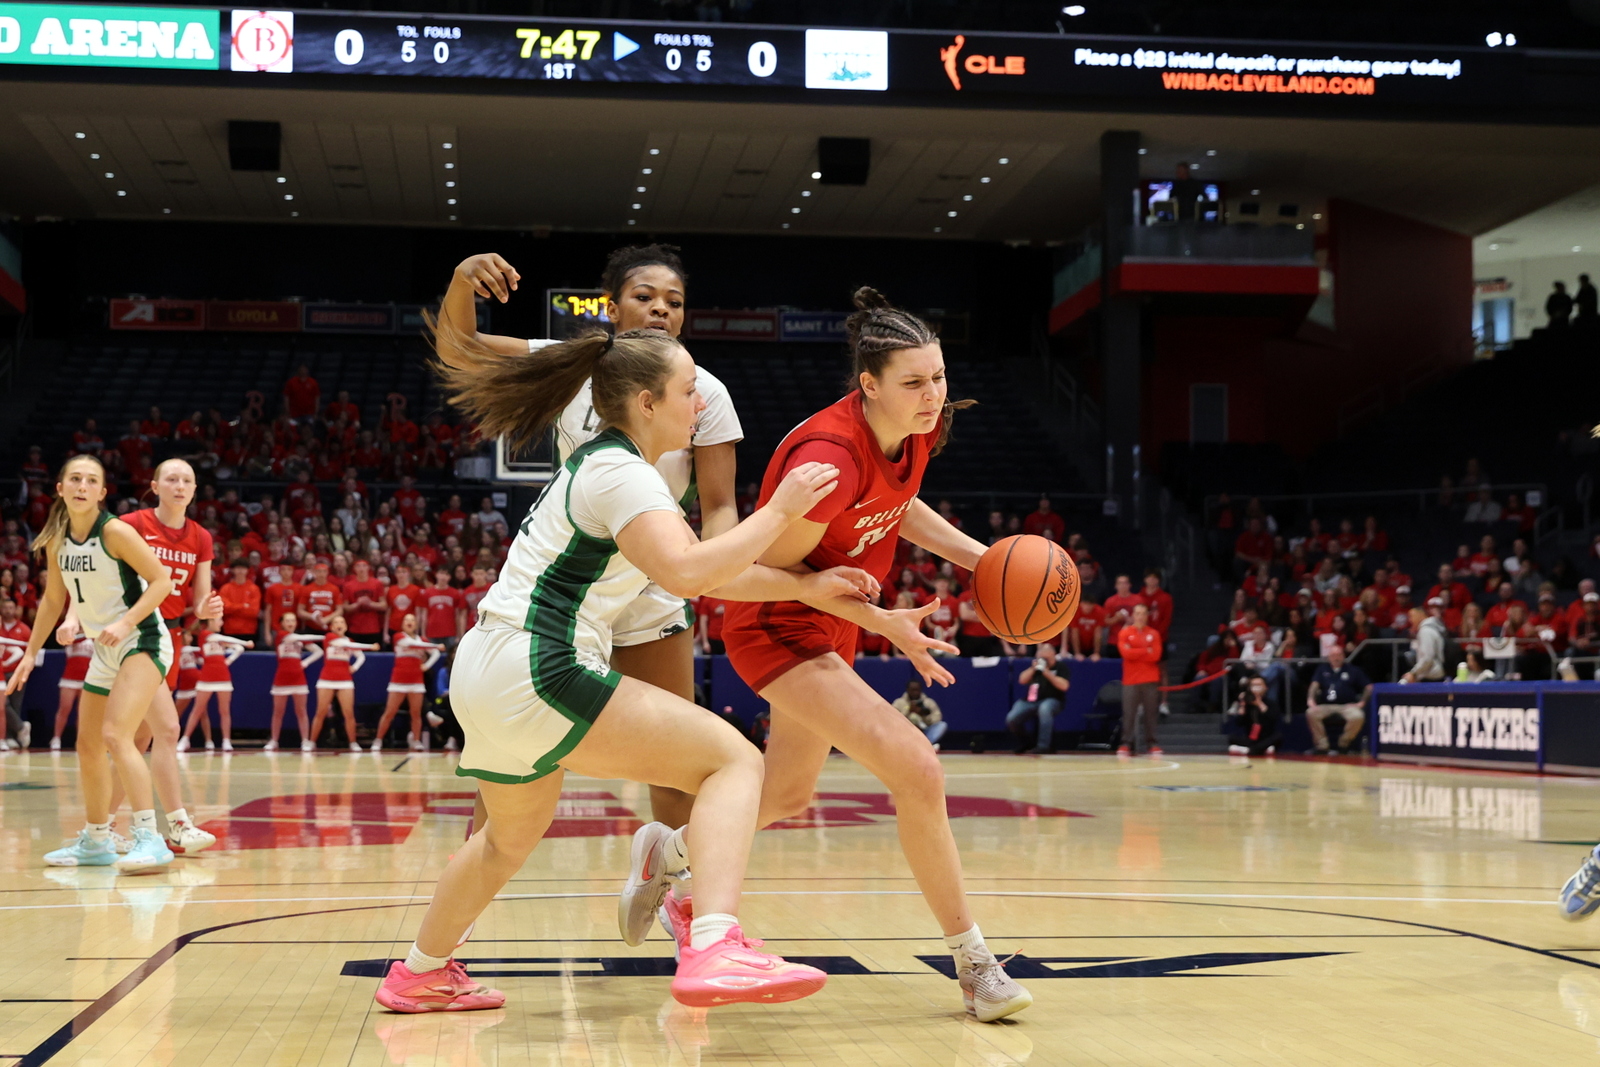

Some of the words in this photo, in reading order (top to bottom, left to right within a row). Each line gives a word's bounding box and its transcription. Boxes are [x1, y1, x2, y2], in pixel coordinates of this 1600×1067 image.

[30, 17, 215, 60] ARENA
[397, 26, 419, 39] TOL
[424, 26, 462, 40] FOULS
[516, 28, 601, 61] 7:47
[654, 33, 691, 47] FOULS
[691, 34, 714, 48] TOL
[334, 29, 365, 66] 0
[401, 40, 416, 63] 5
[433, 41, 449, 64] 0
[747, 41, 778, 78] 0
[543, 63, 576, 80] 1ST
[665, 48, 681, 71] 0
[696, 49, 712, 72] 5
[964, 54, 1026, 76] CLE
[1120, 53, 1132, 67] a
[1168, 51, 1214, 69] initial
[1215, 52, 1277, 73] deposit
[1277, 58, 1296, 71] or
[1297, 55, 1371, 75] purchase
[1371, 60, 1409, 78] gear
[1409, 58, 1461, 80] today!
[1162, 72, 1375, 95] WNBACLEVELAND.COM
[228, 309, 279, 323] LOYOLA
[568, 295, 609, 316] 7:47
[784, 320, 823, 333] SAINT
[59, 554, 97, 572] LAUREL
[73, 578, 85, 604] 1
[1046, 549, 1076, 615] Rawlings
[1378, 704, 1453, 747] DAYTON
[1455, 707, 1540, 751] FLYERS
